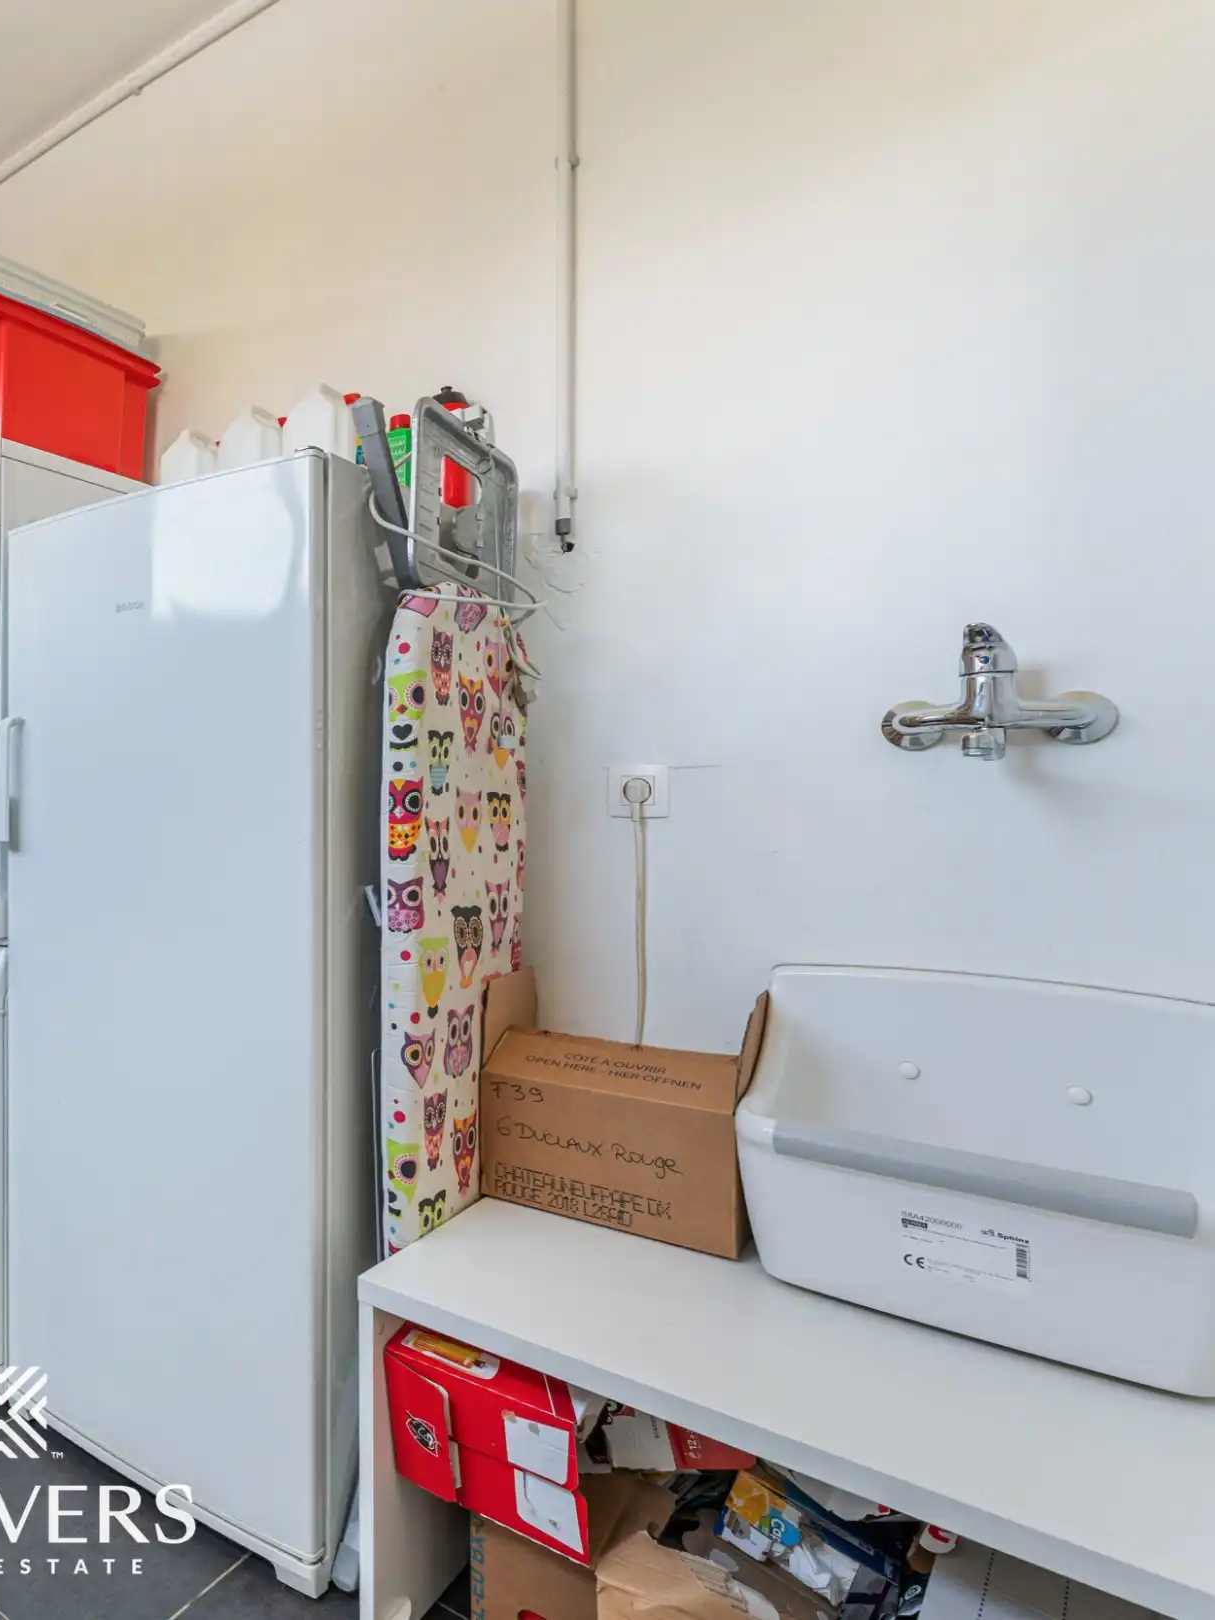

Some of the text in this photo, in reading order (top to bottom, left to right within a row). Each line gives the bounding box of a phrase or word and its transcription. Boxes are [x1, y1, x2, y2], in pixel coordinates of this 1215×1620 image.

[526, 1054, 561, 1068] OPEN
[563, 1061, 597, 1073] HERE
[607, 1069, 640, 1080] HIER
[614, 1061, 667, 1075] OUVRIR
[611, 1142, 684, 1180] Rouge
[997, 1232, 1030, 1245] Sphinx
